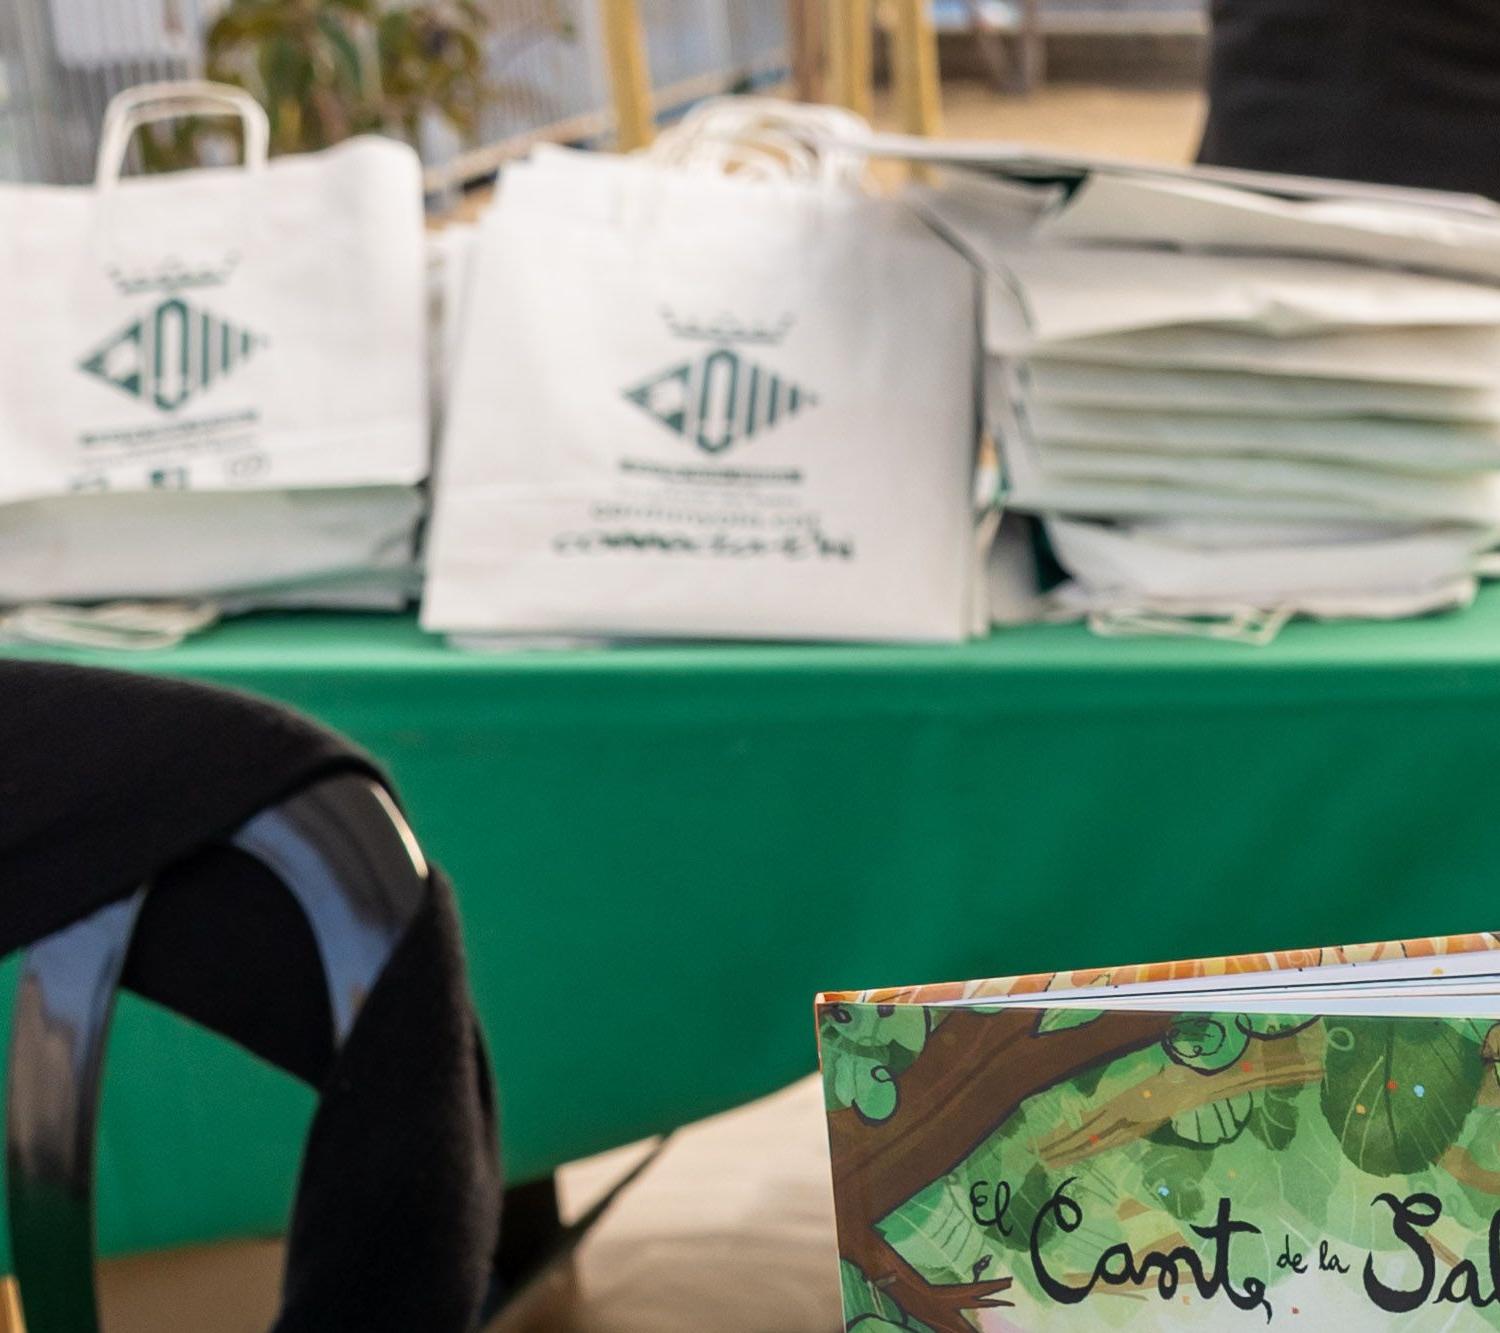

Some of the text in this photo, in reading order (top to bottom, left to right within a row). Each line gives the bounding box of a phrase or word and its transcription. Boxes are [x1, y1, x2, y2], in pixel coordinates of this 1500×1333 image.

[970, 1180, 1011, 1235] El
[1030, 1176, 1273, 1323] Cant
[1277, 1235, 1308, 1274] de
[1319, 1241, 1350, 1274] la
